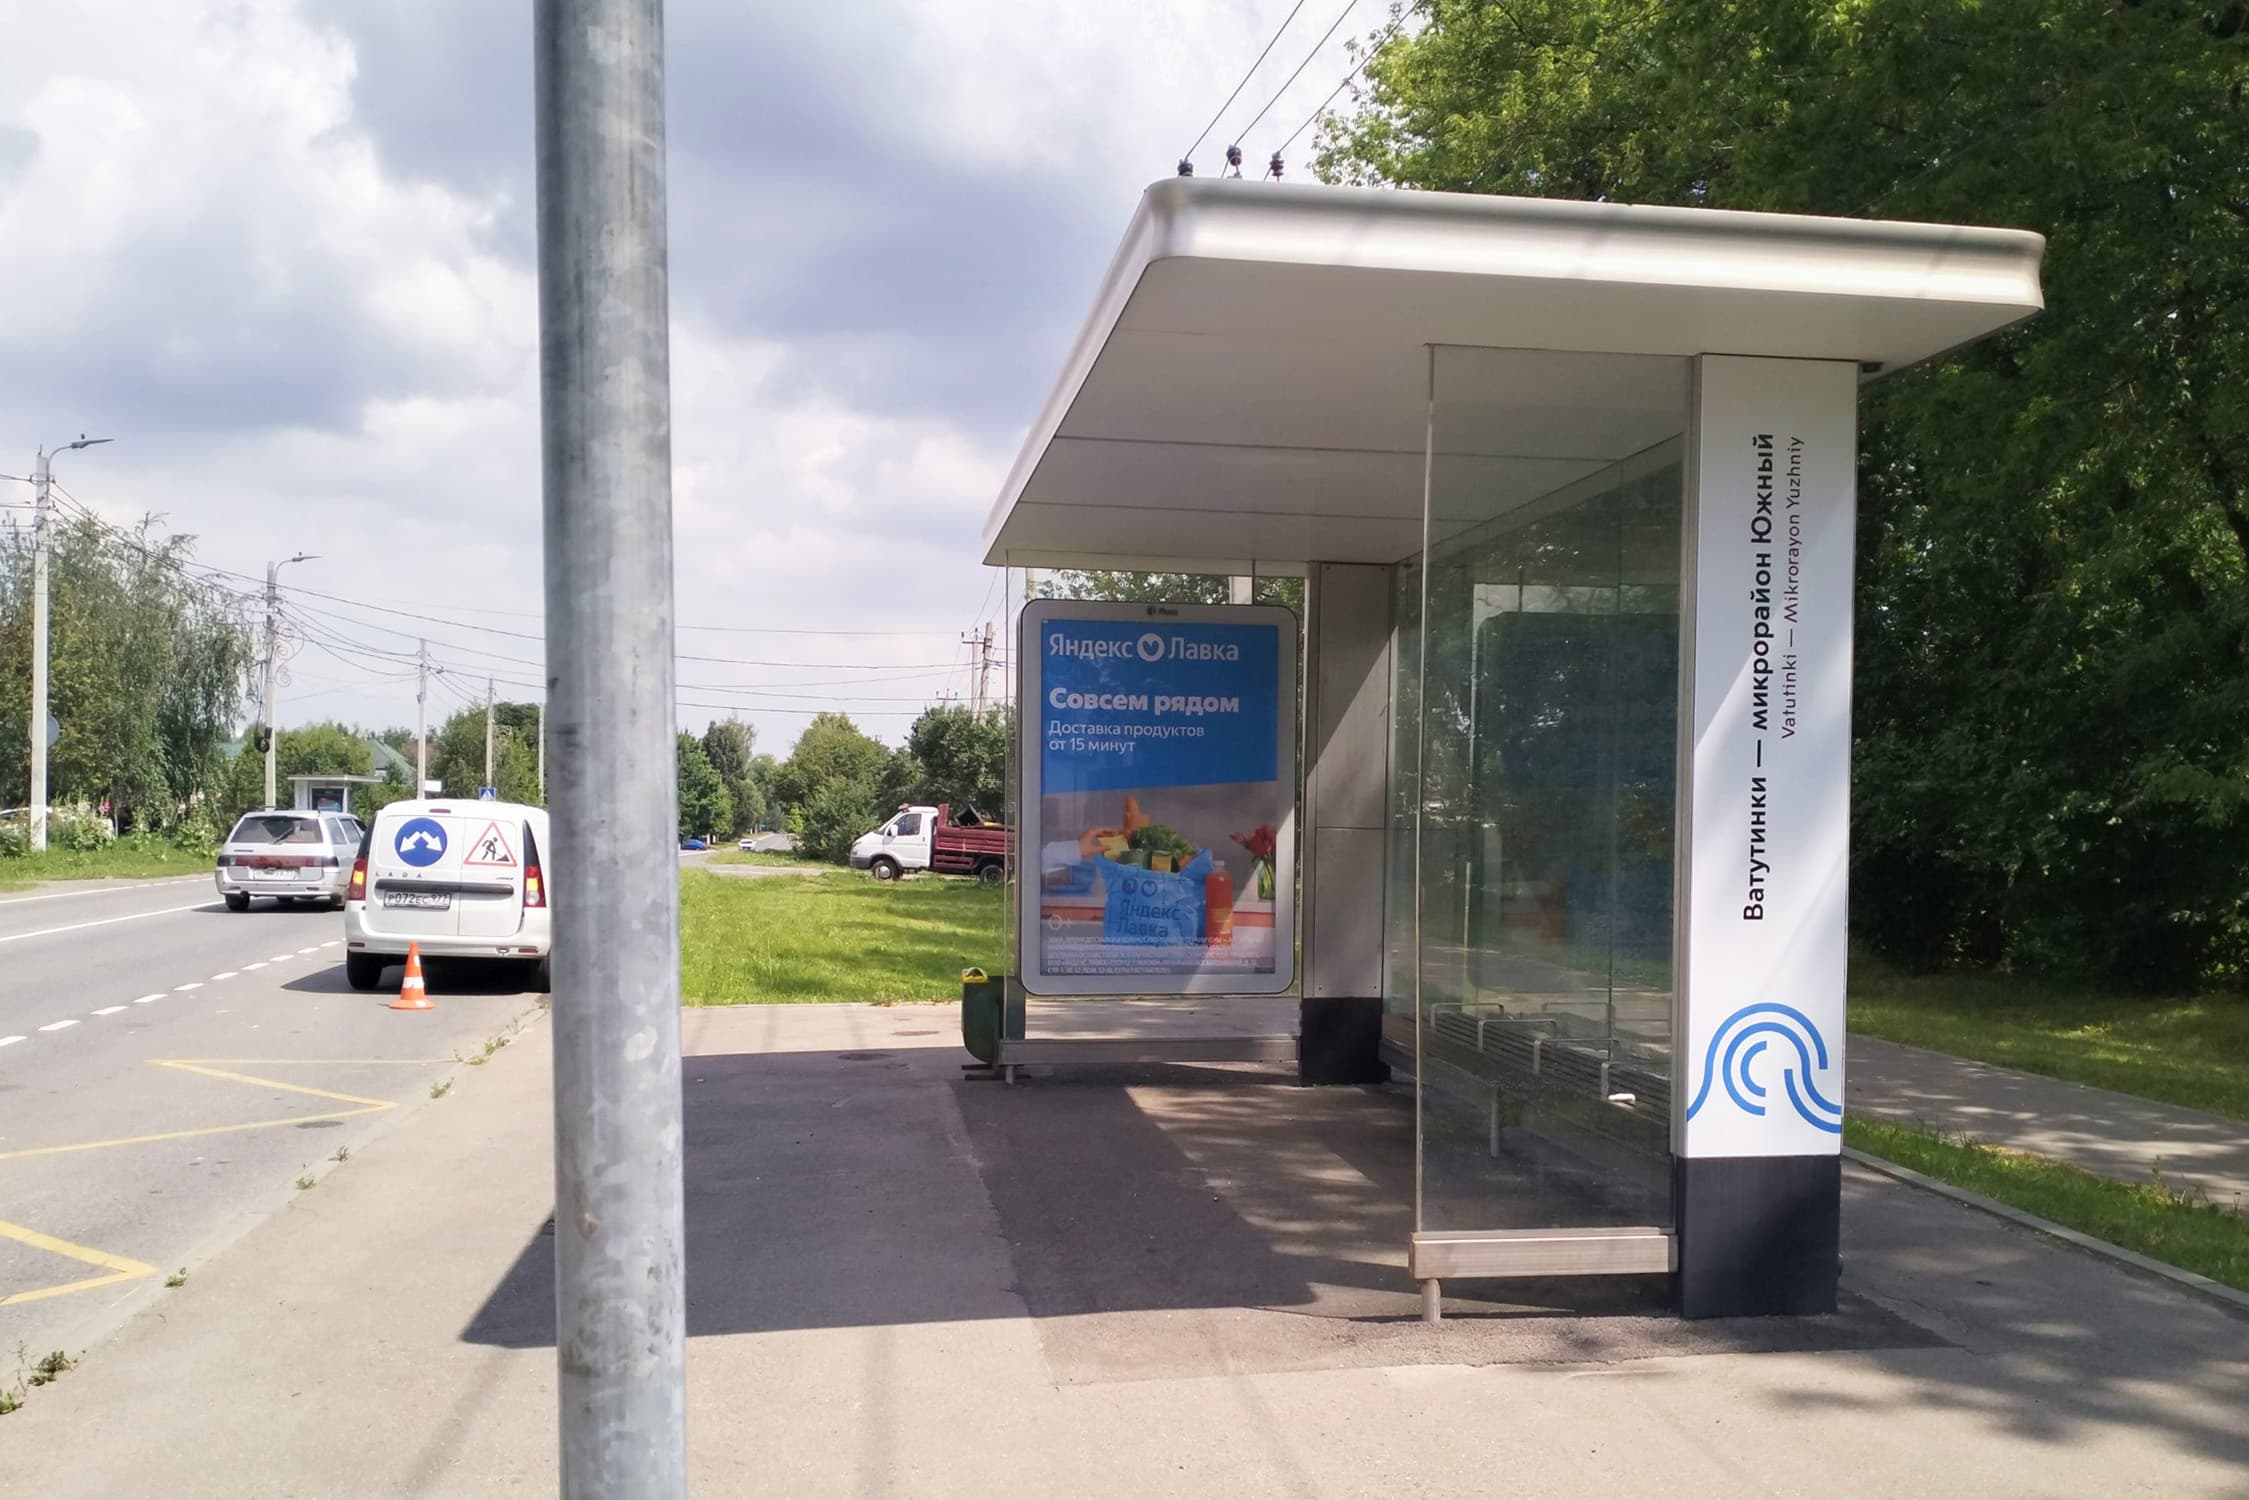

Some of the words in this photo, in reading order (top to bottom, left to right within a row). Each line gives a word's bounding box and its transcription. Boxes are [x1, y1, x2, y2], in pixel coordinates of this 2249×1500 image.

[1786, 436, 1804, 510] Yuzhniy
[1750, 434, 1774, 544] Южный
[1784, 514, 1802, 623] Mikrorayon
[1049, 633, 1133, 658] Яндекс
[1168, 637, 1239, 661] Лавка
[1750, 553, 1774, 731] микрорайон
[1049, 687, 1148, 711] Совсем
[1154, 695, 1239, 716] рядом
[1781, 654, 1797, 739] Vatutinki
[1048, 720, 1121, 736] Доставка
[1124, 724, 1205, 739] продуктов
[1049, 740, 1065, 751] от
[1070, 738, 1085, 751] 15
[1088, 741, 1135, 755] минут
[1743, 777, 1770, 920] Ватутинки
[375, 871, 422, 879] LADA
[1120, 899, 1180, 920] Яндекс
[1116, 917, 1168, 937] Лавка
